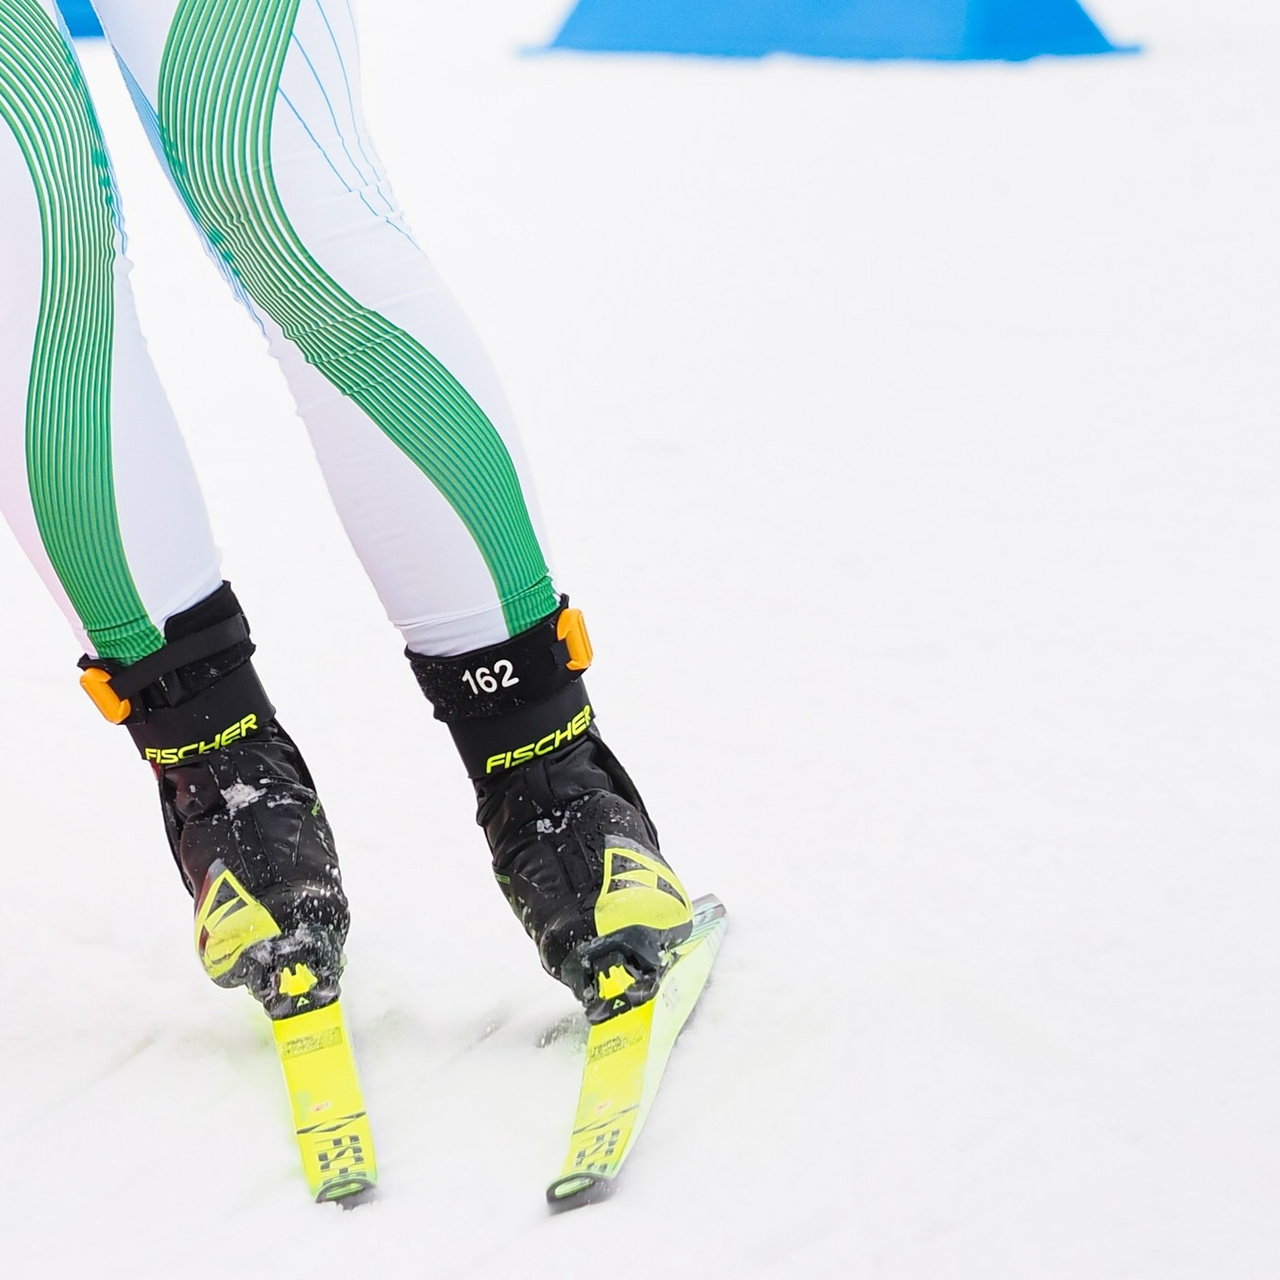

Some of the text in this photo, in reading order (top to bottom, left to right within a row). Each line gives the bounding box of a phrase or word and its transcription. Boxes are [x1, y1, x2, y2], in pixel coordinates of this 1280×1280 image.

[461, 659, 520, 696] 162
[145, 713, 259, 765] FISCHER
[486, 704, 593, 774] FISCHER
